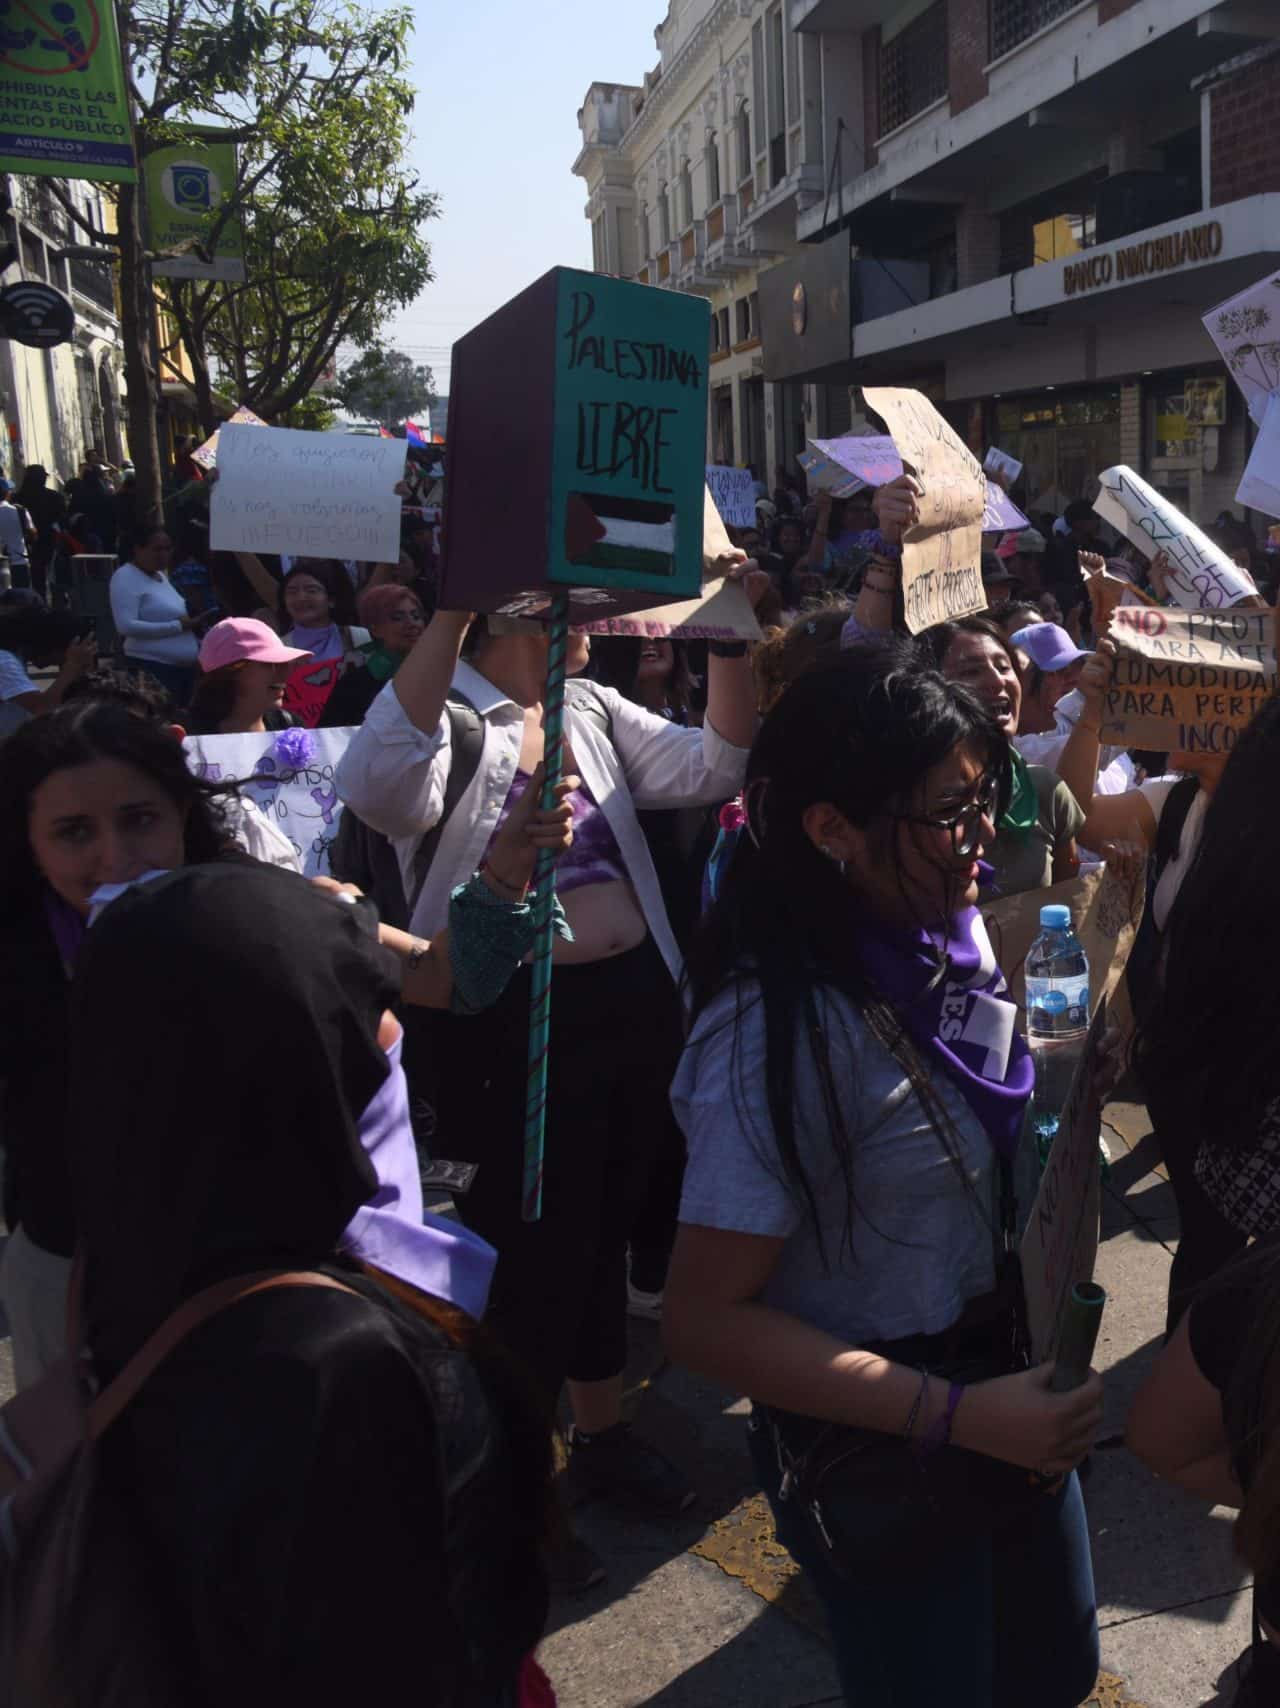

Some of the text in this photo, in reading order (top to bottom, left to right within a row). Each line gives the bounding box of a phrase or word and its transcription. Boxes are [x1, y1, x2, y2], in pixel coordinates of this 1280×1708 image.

[86, 89, 117, 105] LAS
[58, 103, 82, 117] EN
[87, 105, 108, 120] EL
[49, 115, 126, 137] PÚBLICO
[1064, 221, 1222, 297] BANCO INMOBILIARIO
[564, 291, 703, 390] PALESTINA
[576, 401, 679, 493] LIBRE
[1116, 609, 1168, 638] NO
[1105, 690, 1176, 718] PARA
